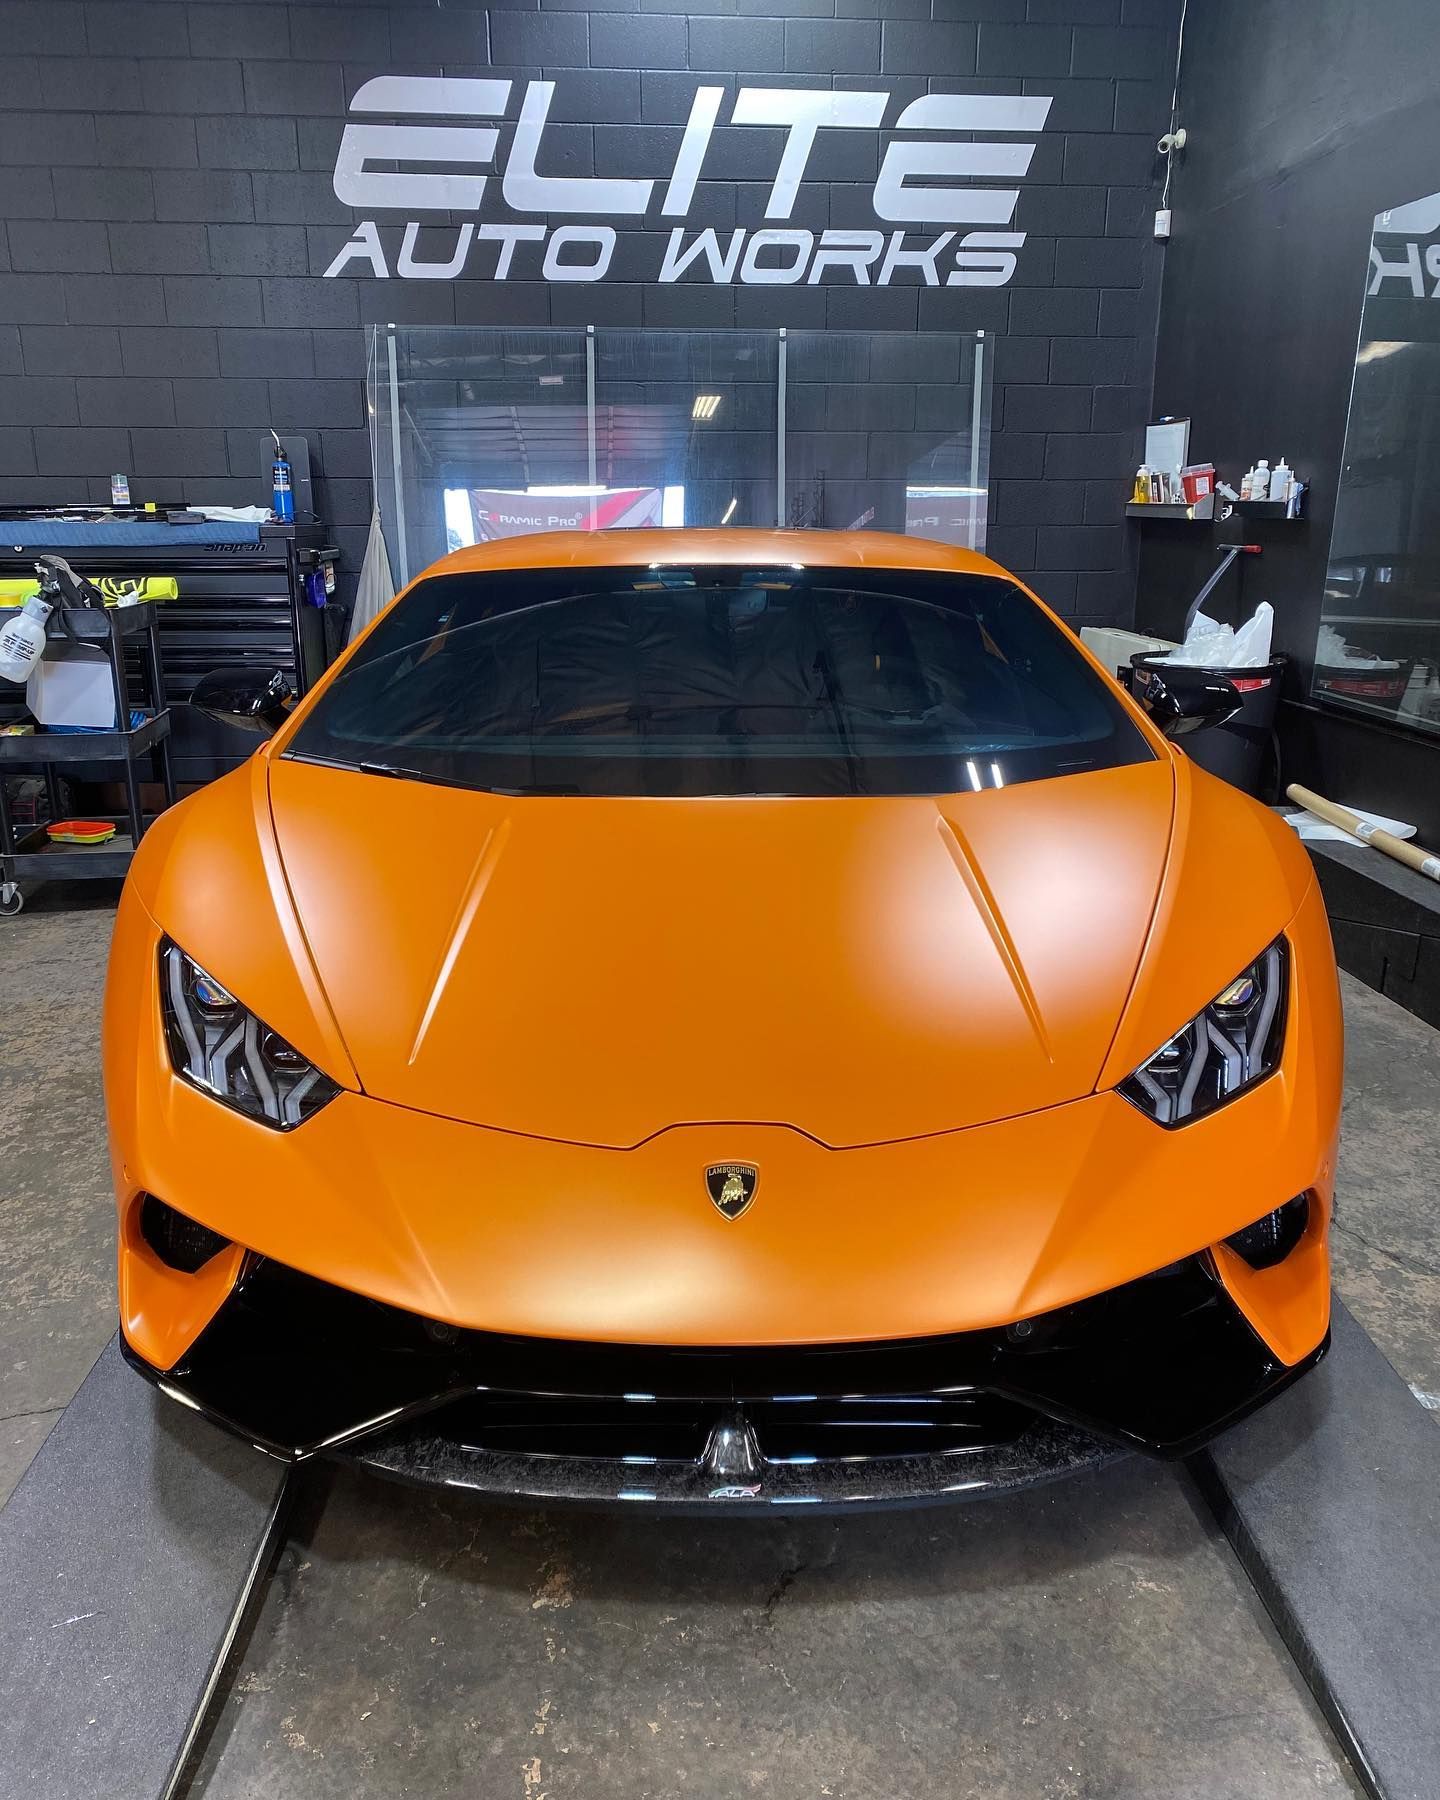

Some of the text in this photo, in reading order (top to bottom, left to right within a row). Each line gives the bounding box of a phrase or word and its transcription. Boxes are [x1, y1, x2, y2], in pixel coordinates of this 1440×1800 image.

[333, 75, 1054, 224] ELITE
[322, 221, 1027, 286] AUTO WORKS
[708, 1166, 755, 1177] LAMBORGHINI
